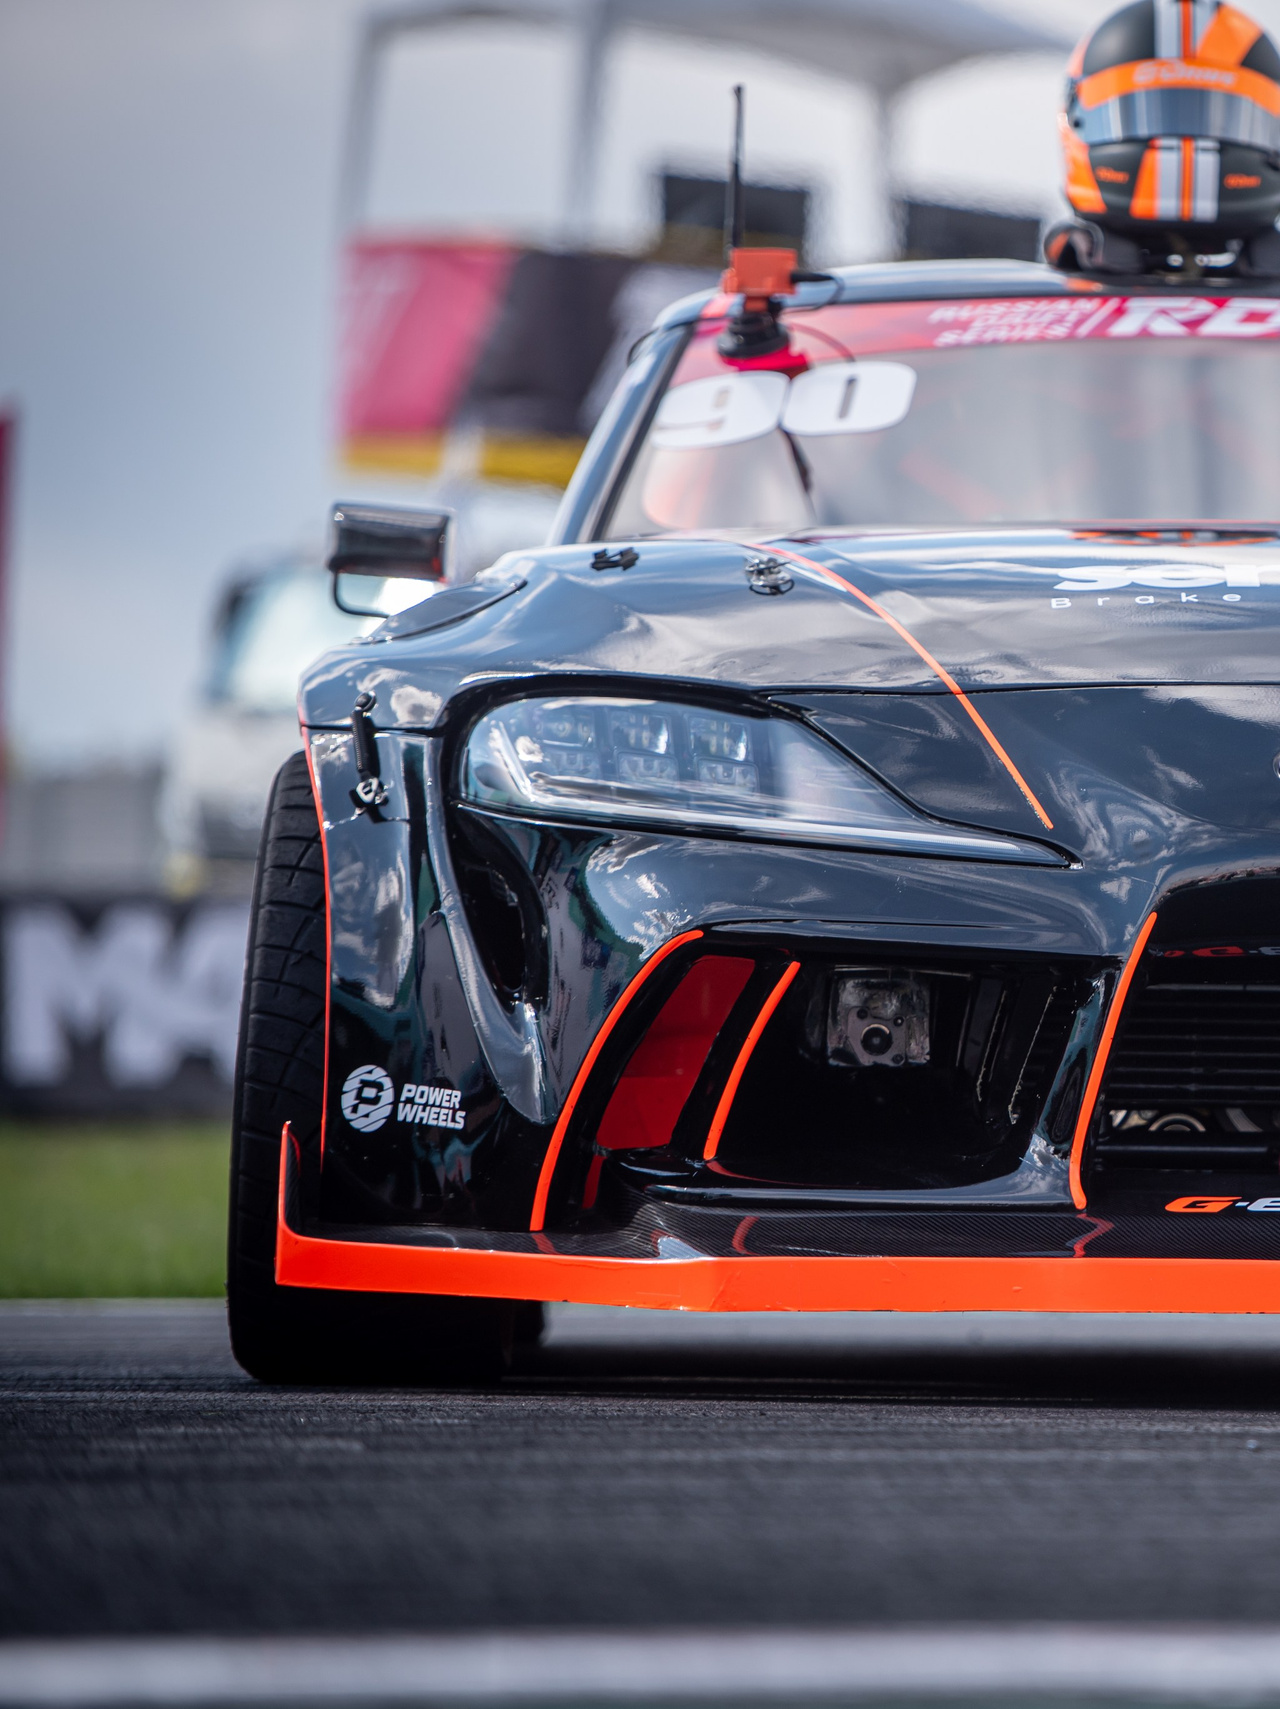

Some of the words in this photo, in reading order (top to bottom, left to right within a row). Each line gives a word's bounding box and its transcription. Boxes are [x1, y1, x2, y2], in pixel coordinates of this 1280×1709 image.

[651, 361, 917, 449] 90
[1050, 592, 1242, 609] Brake
[399, 1083, 462, 1109] POWER
[397, 1102, 467, 1130] WHEELS
